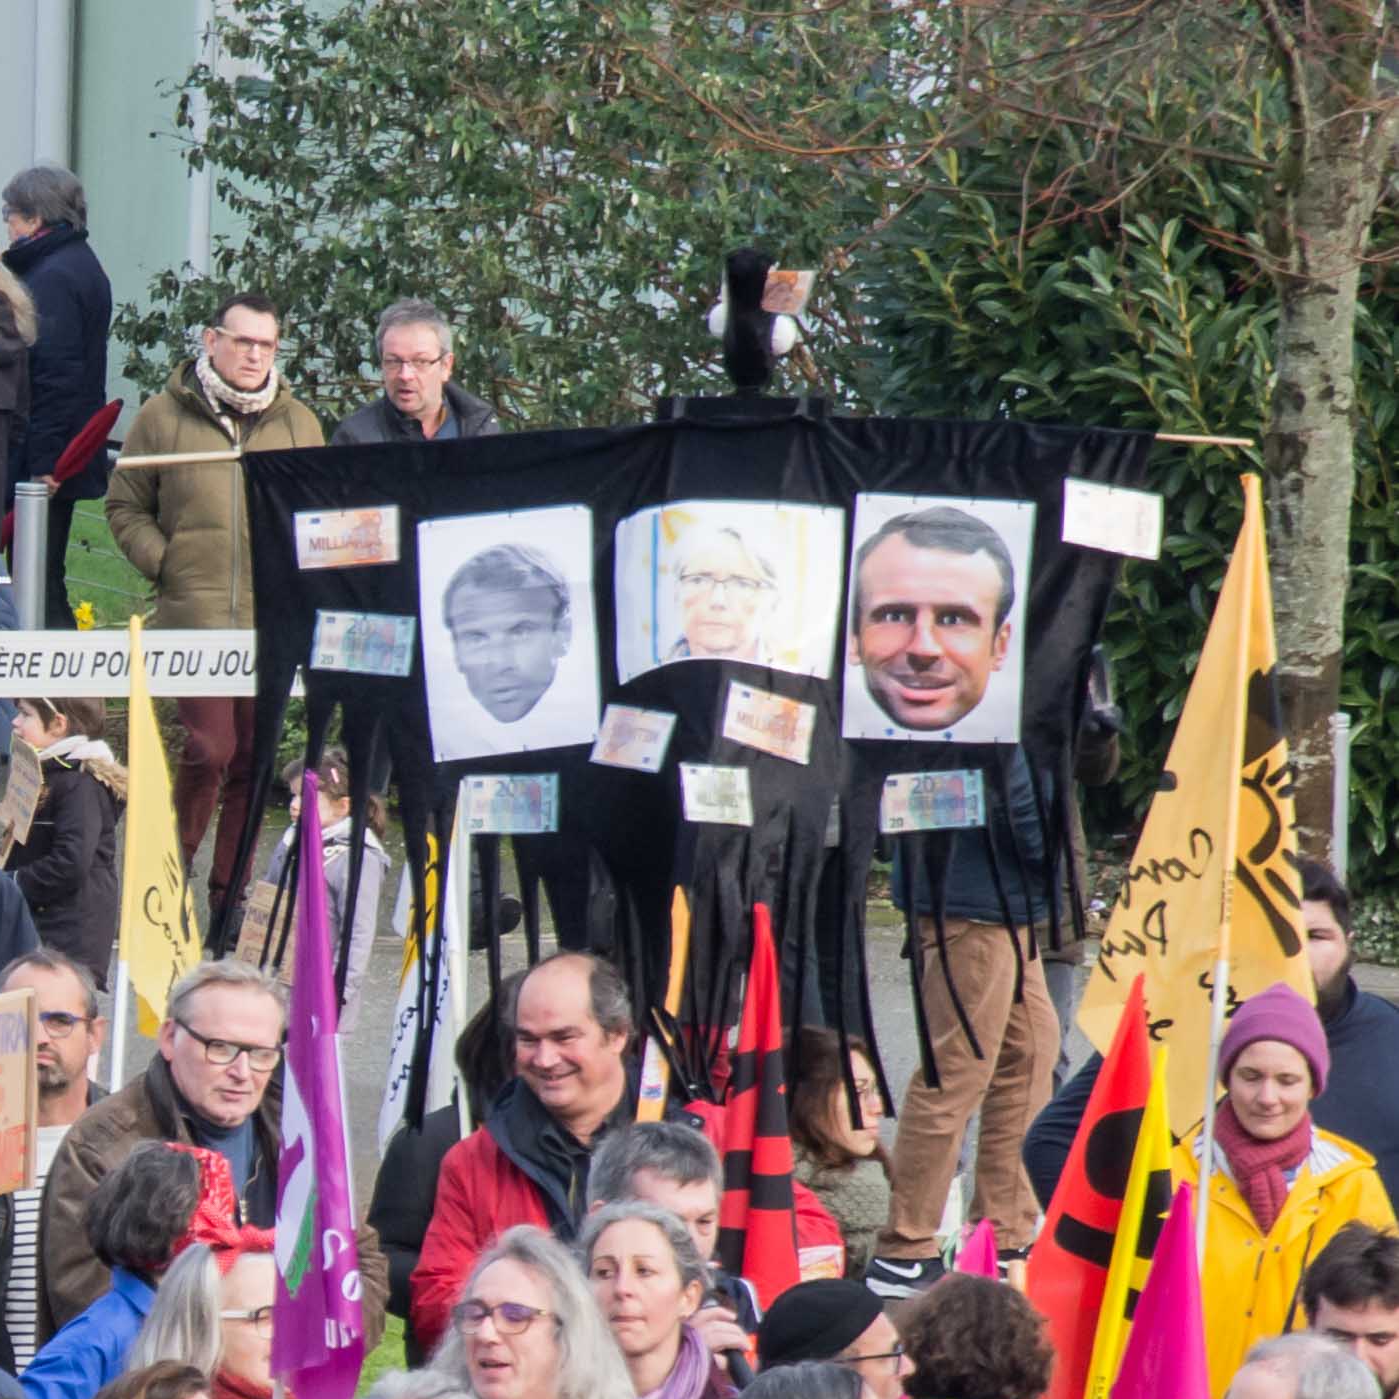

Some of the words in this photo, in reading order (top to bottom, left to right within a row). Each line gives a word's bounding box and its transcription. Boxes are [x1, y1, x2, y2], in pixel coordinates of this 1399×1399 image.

[50, 652, 85, 679] DU
[90, 651, 164, 677] POIT
[168, 650, 202, 678] DU
[209, 650, 256, 677] JOU
